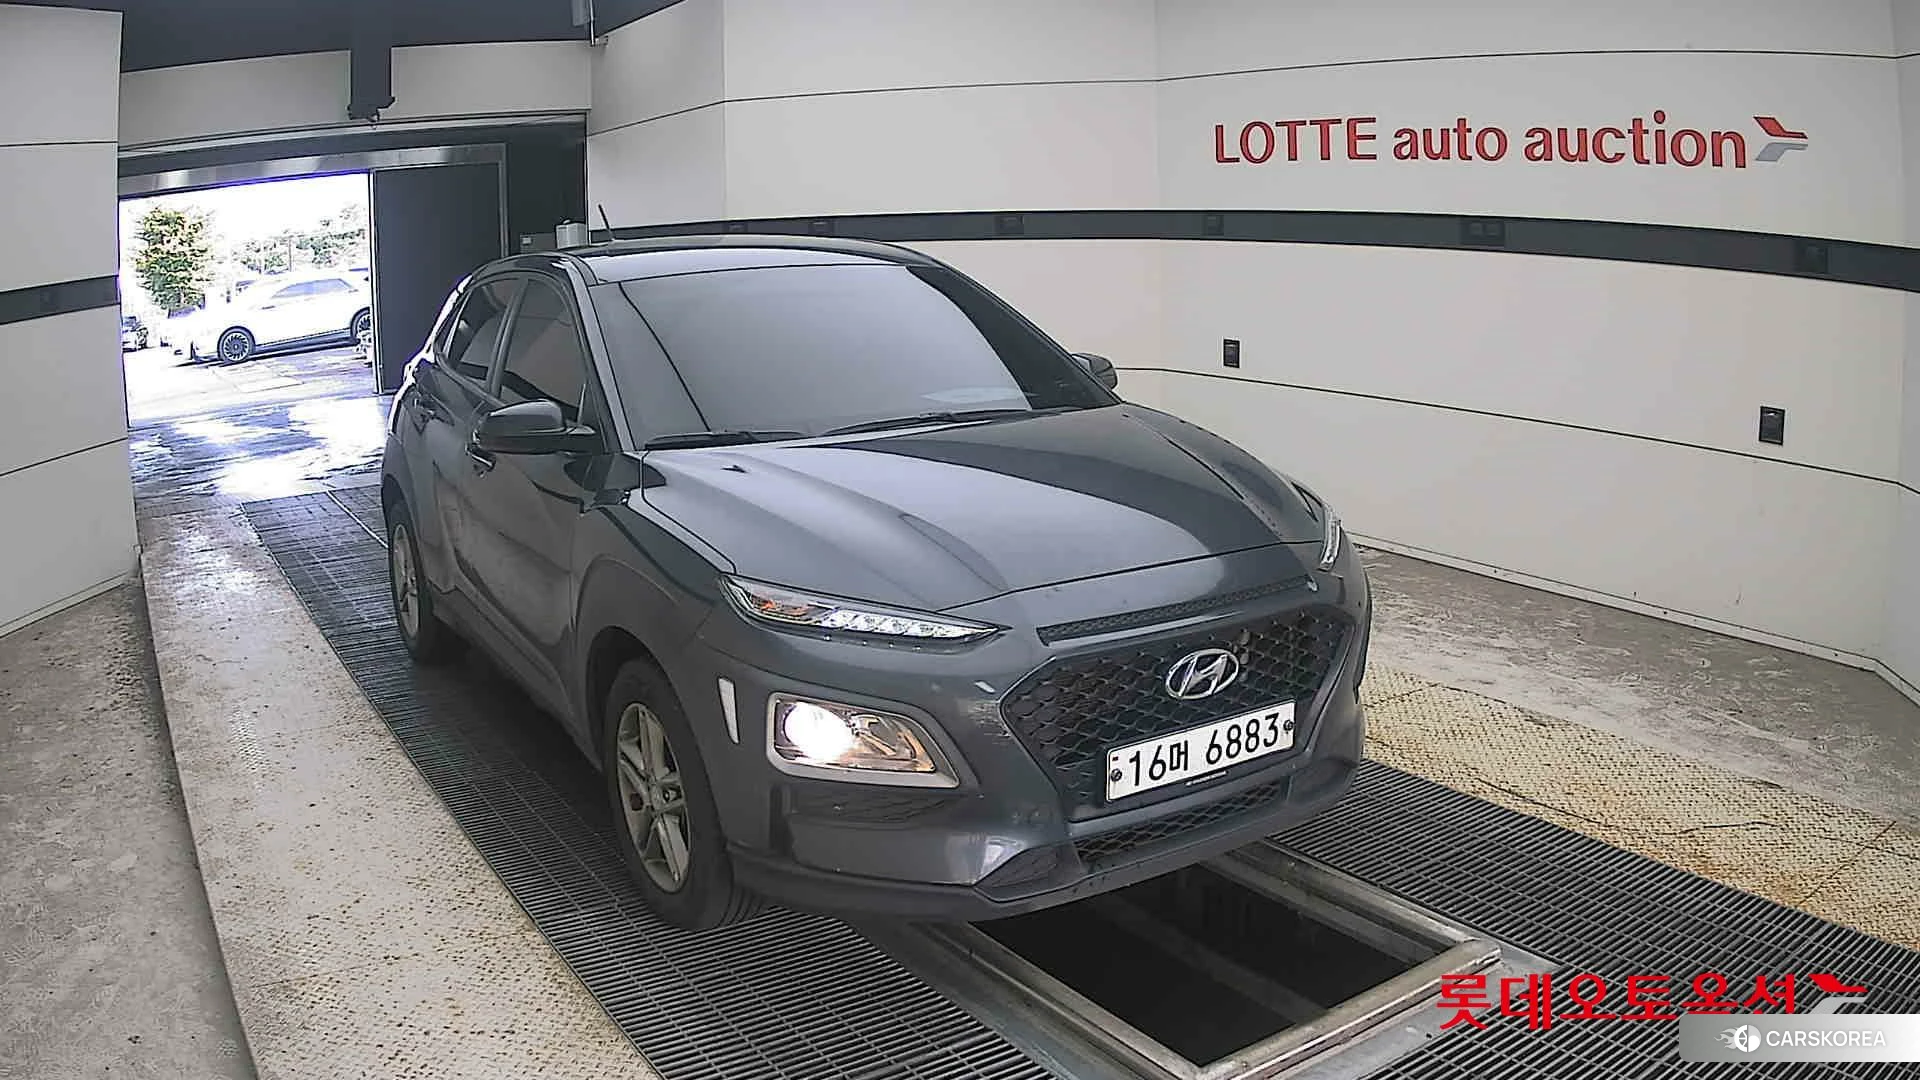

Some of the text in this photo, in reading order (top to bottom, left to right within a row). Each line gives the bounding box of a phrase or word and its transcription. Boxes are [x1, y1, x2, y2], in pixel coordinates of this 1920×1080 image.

[1215, 110, 1746, 168] LOTTE auto auction
[1129, 712, 1279, 786] 16머 6883
